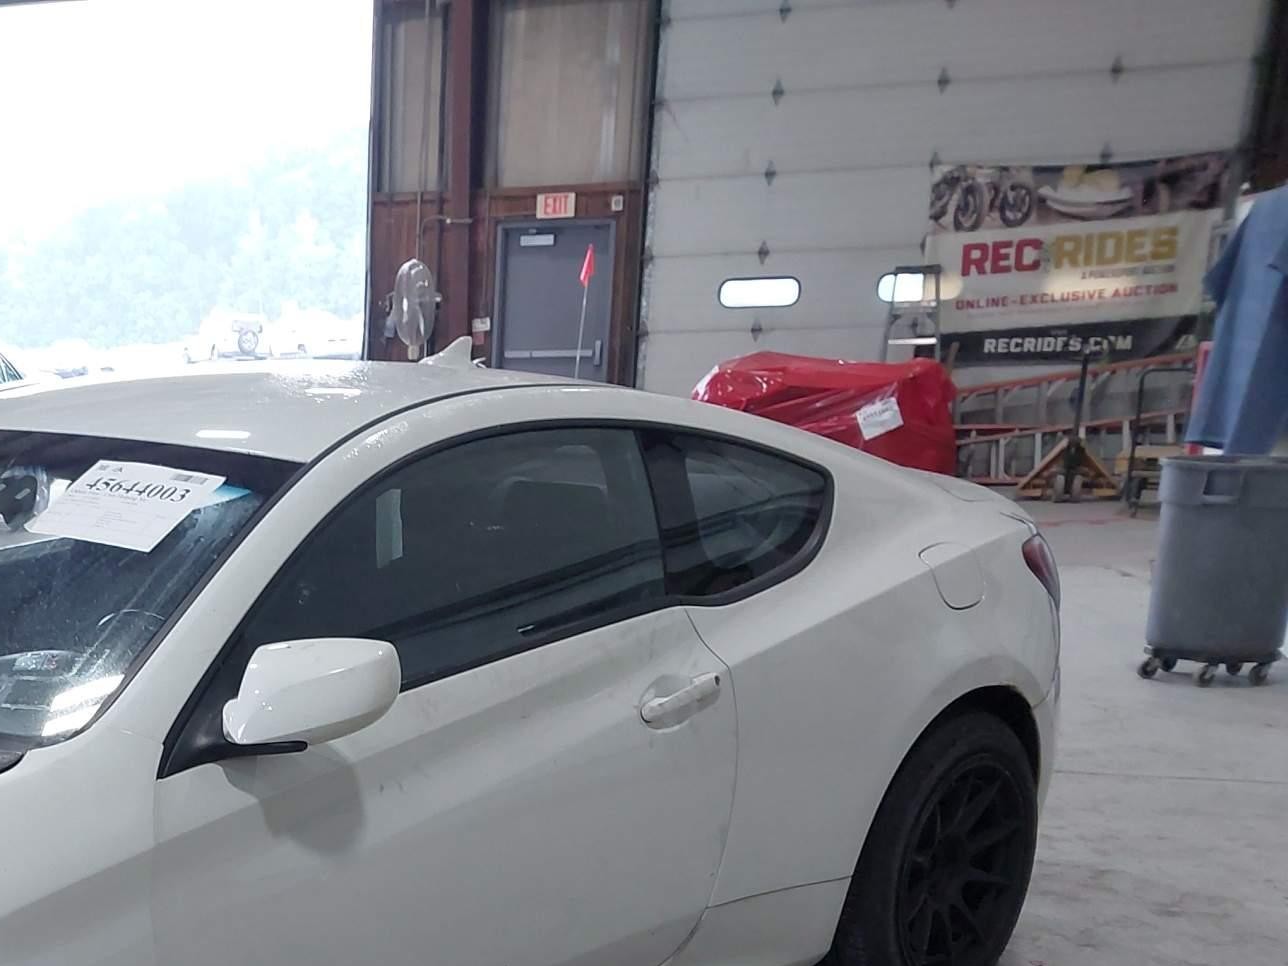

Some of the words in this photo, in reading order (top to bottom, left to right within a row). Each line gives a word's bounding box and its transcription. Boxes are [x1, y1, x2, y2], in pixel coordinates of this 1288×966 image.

[543, 194, 569, 215] EXIT
[961, 238, 1044, 277] REC
[1053, 226, 1180, 270] RIDES
[955, 288, 1106, 311] ONLINE-EXCLUSIVE
[1111, 282, 1179, 298] AUCTION
[85, 476, 192, 504] 45644003
